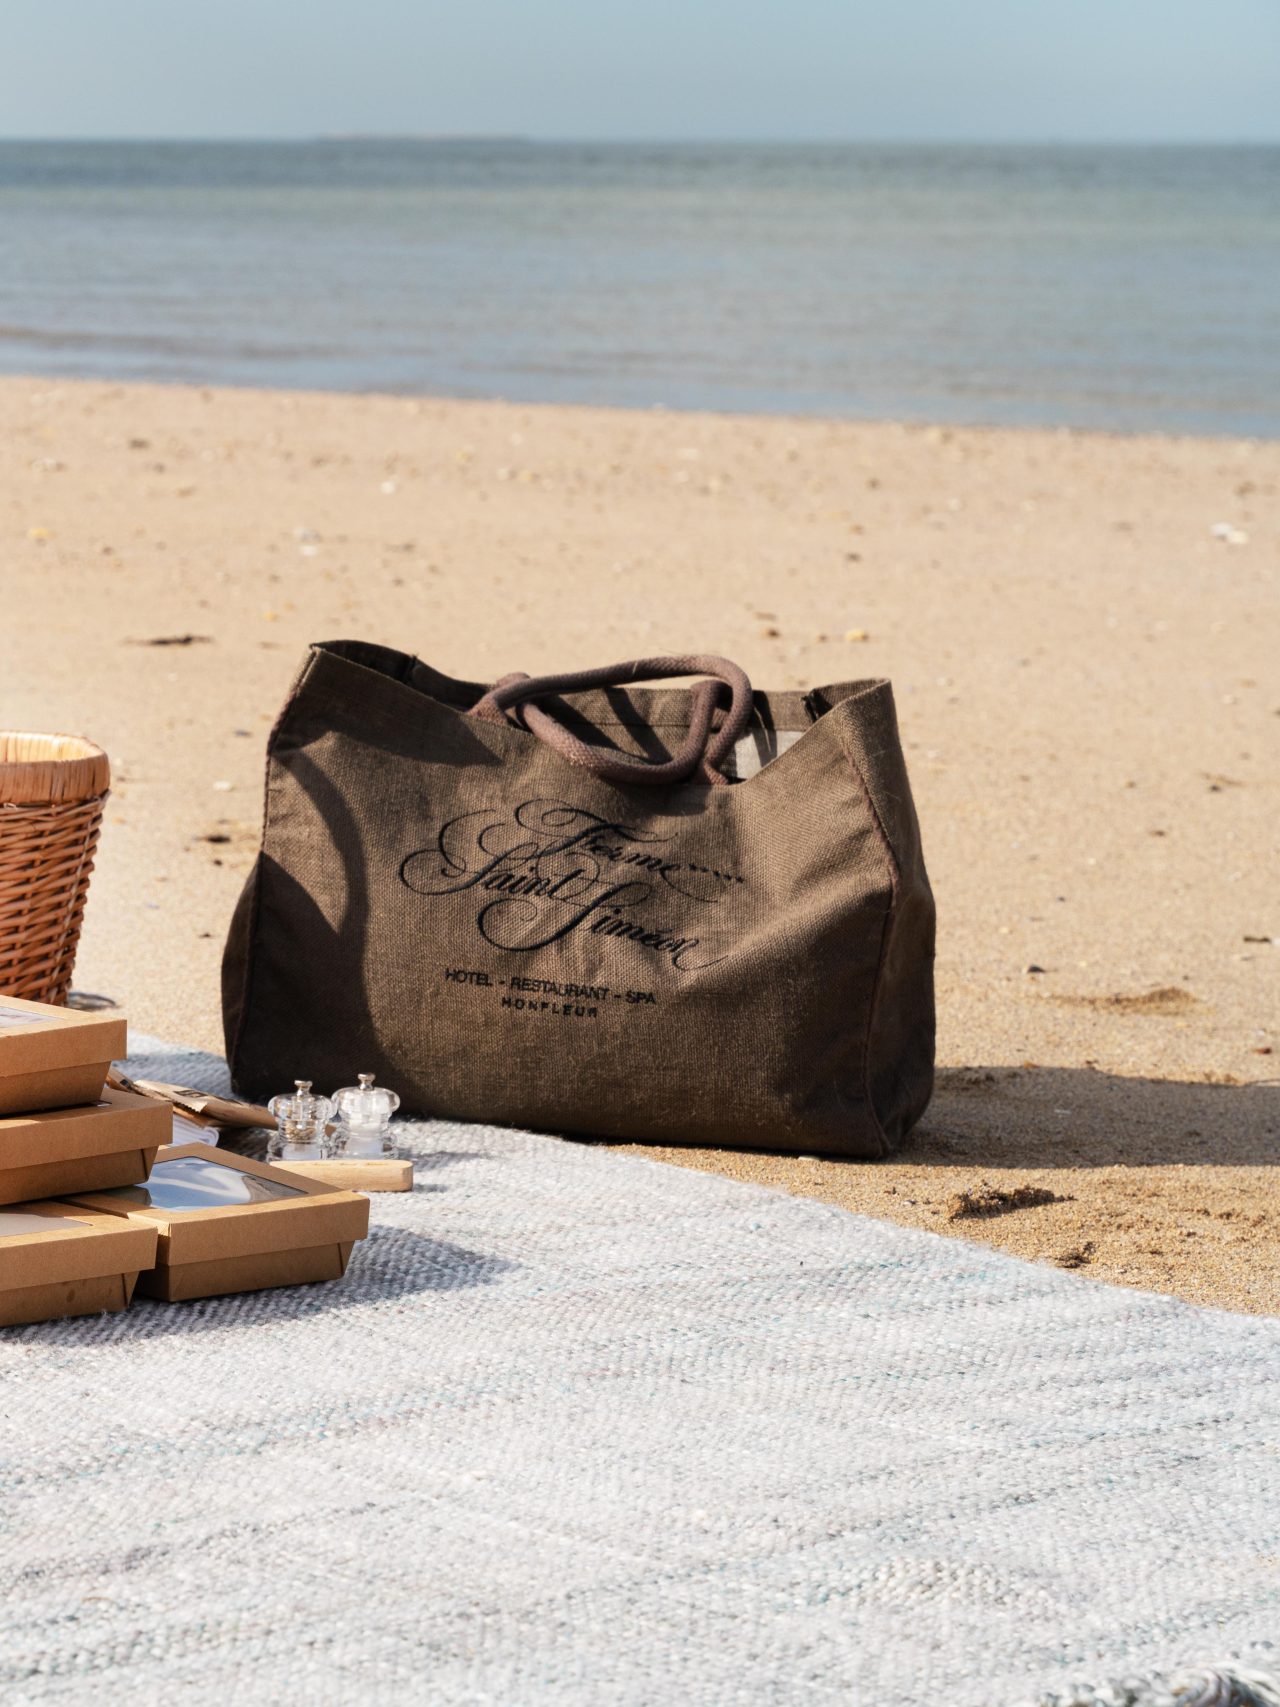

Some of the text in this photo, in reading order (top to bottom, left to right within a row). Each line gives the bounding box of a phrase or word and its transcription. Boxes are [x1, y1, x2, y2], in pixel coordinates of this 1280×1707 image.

[399, 808, 602, 898] Saint
[510, 976, 610, 1000] RESTAURANT
[625, 990, 657, 1005] SPA
[501, 997, 598, 1018] HONFLEUR
